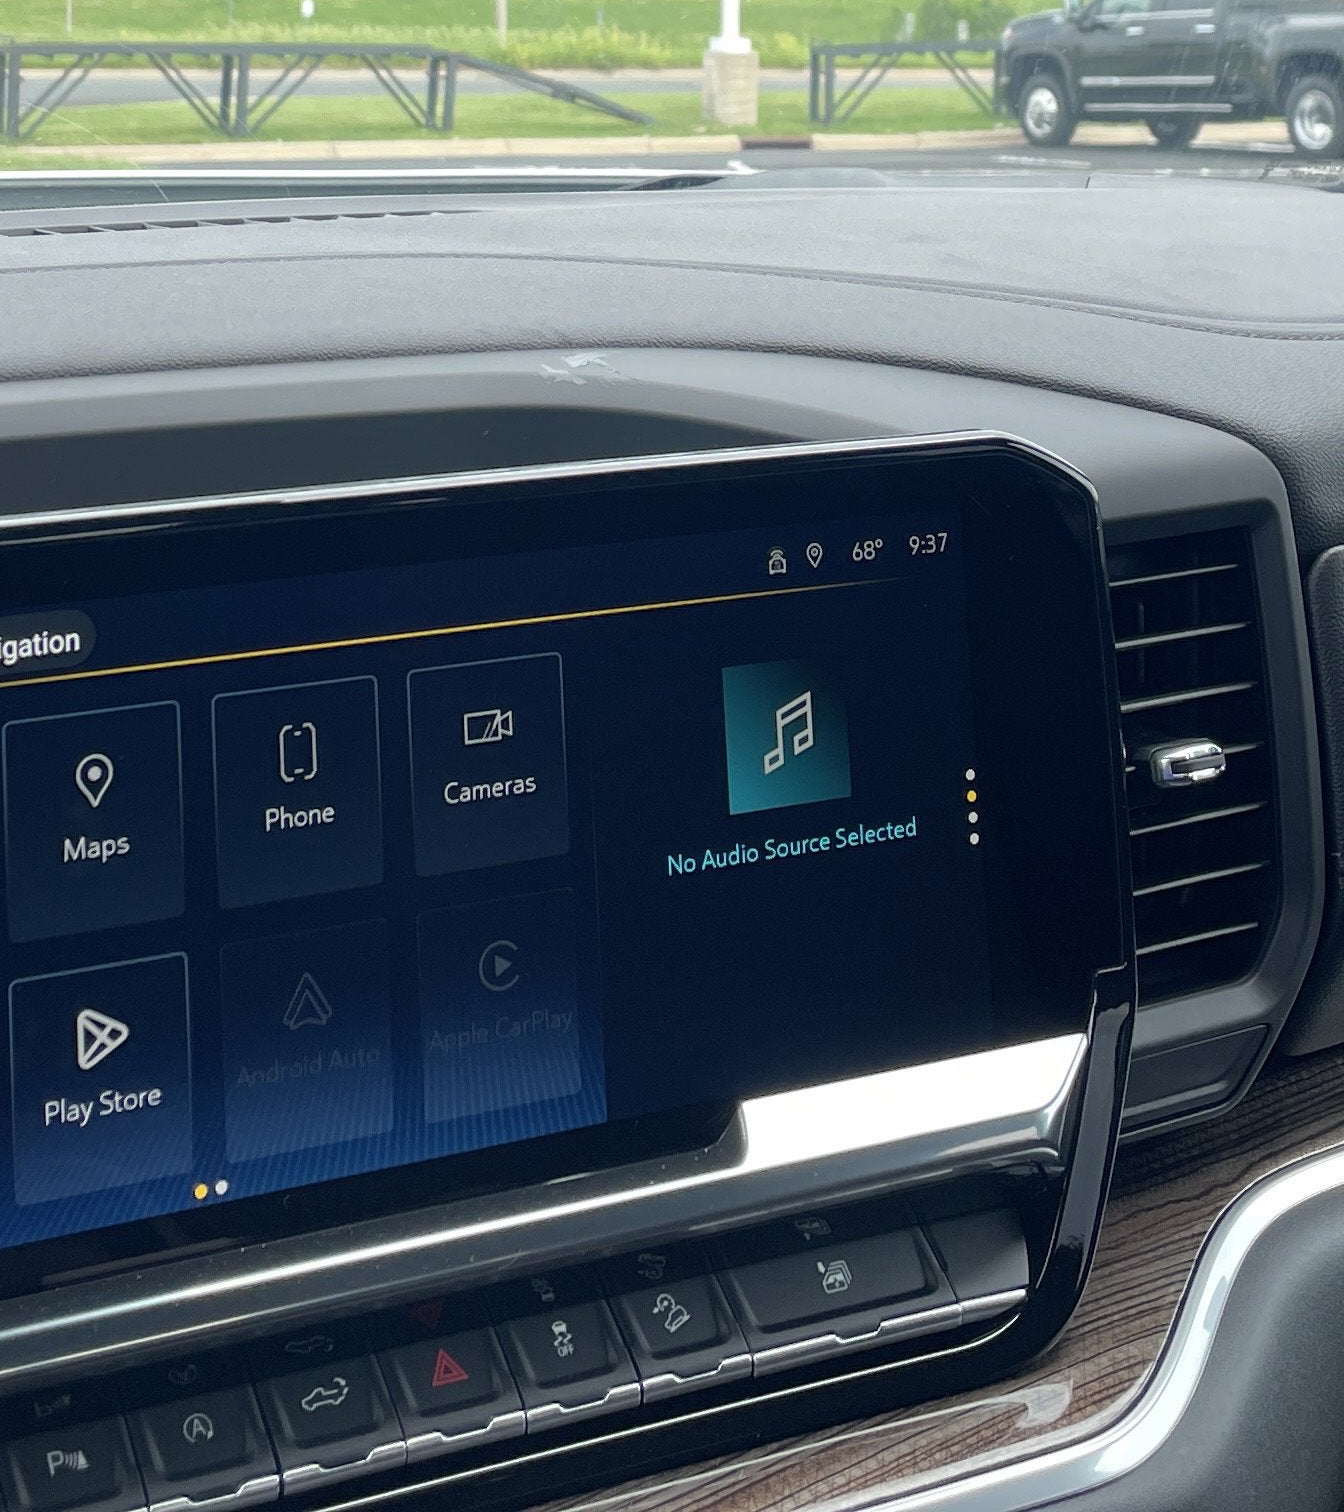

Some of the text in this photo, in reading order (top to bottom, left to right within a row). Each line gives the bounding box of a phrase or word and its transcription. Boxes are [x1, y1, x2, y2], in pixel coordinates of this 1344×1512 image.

[908, 532, 948, 556] 9:37
[443, 776, 537, 806] Cameras
[264, 805, 336, 833] Phone
[63, 835, 131, 864] Maps
[667, 815, 917, 877] No Audio Source Selected
[44, 1087, 163, 1128] Play Store
